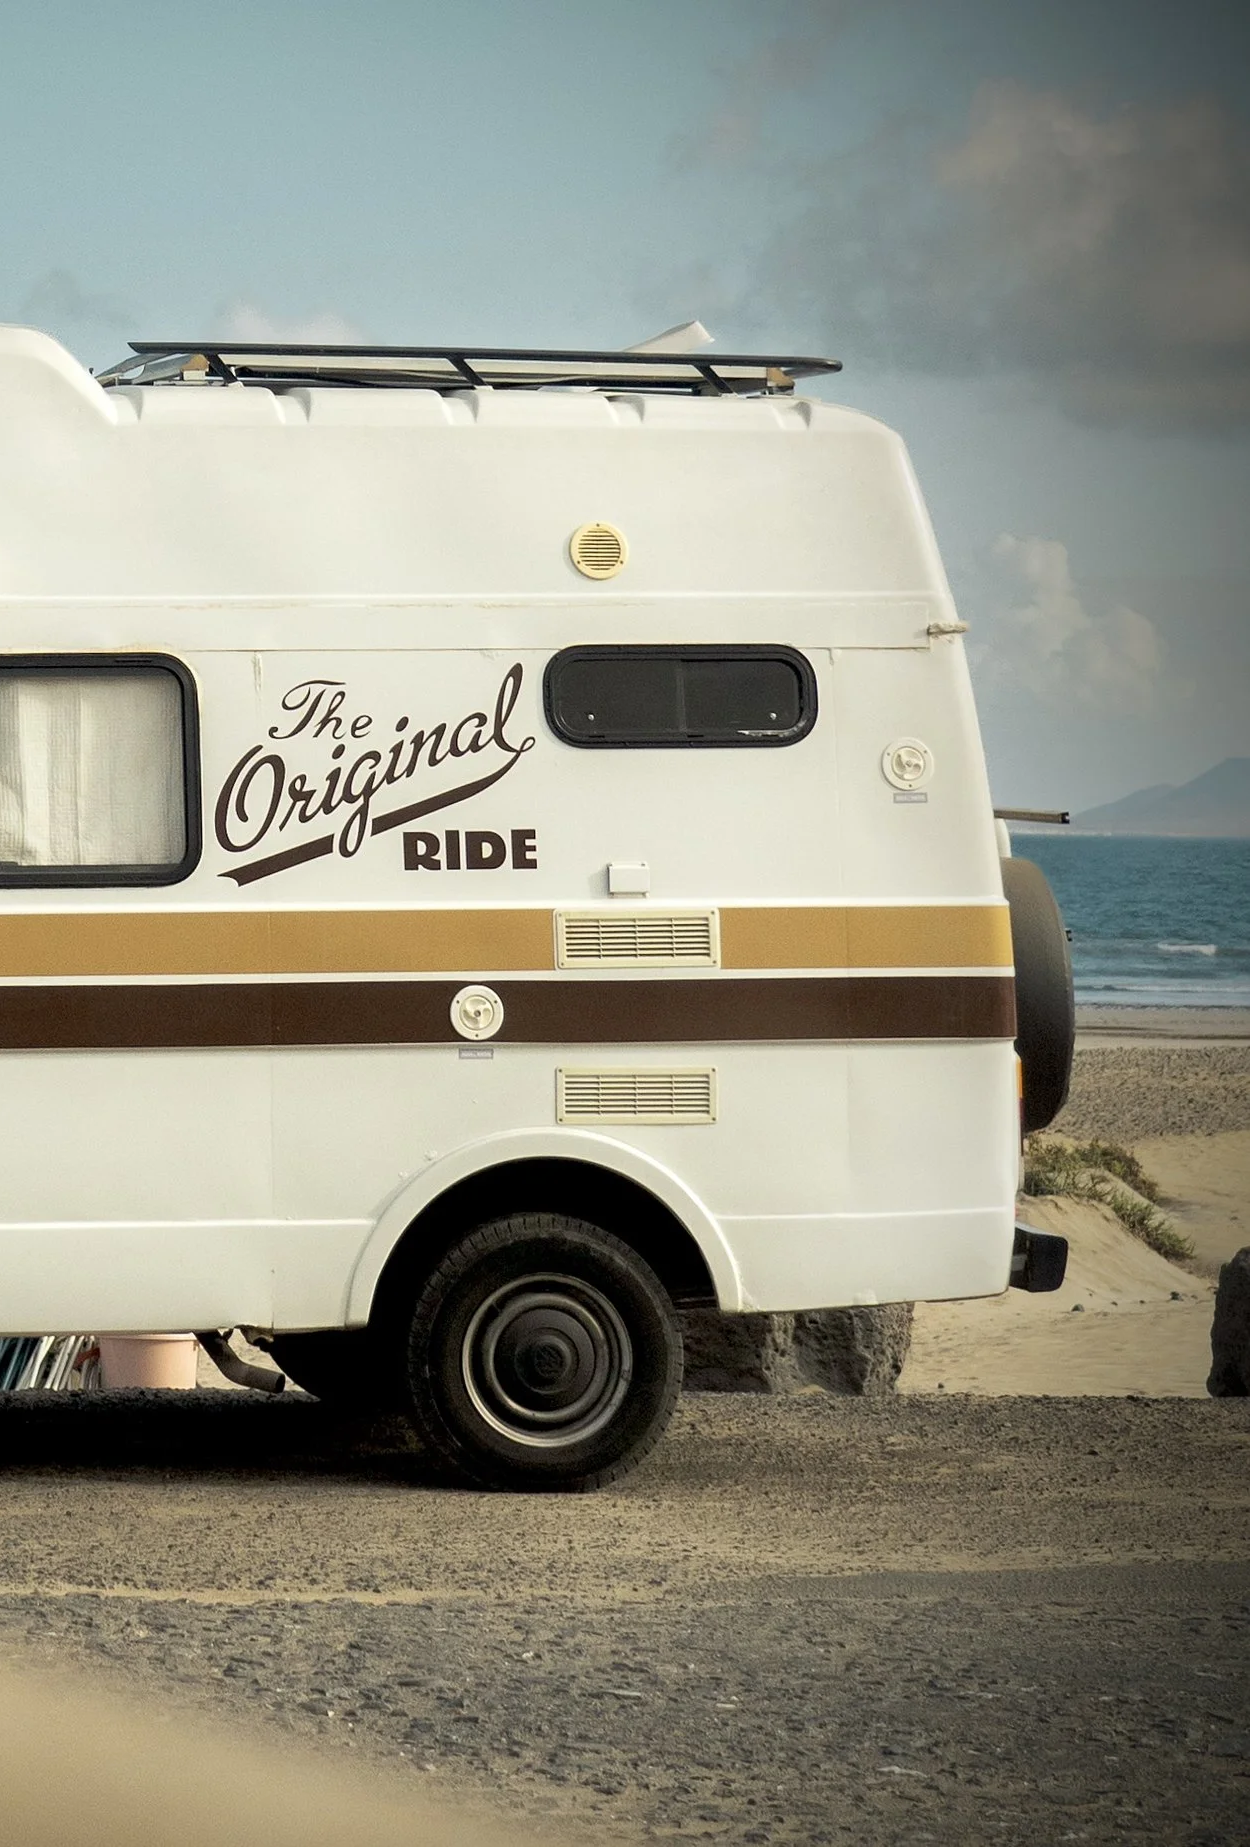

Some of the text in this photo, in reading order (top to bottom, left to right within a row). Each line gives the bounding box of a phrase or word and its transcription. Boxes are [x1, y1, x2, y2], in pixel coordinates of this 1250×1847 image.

[268, 679, 373, 740] The
[214, 662, 536, 859] Original
[402, 828, 538, 871] RIDE
